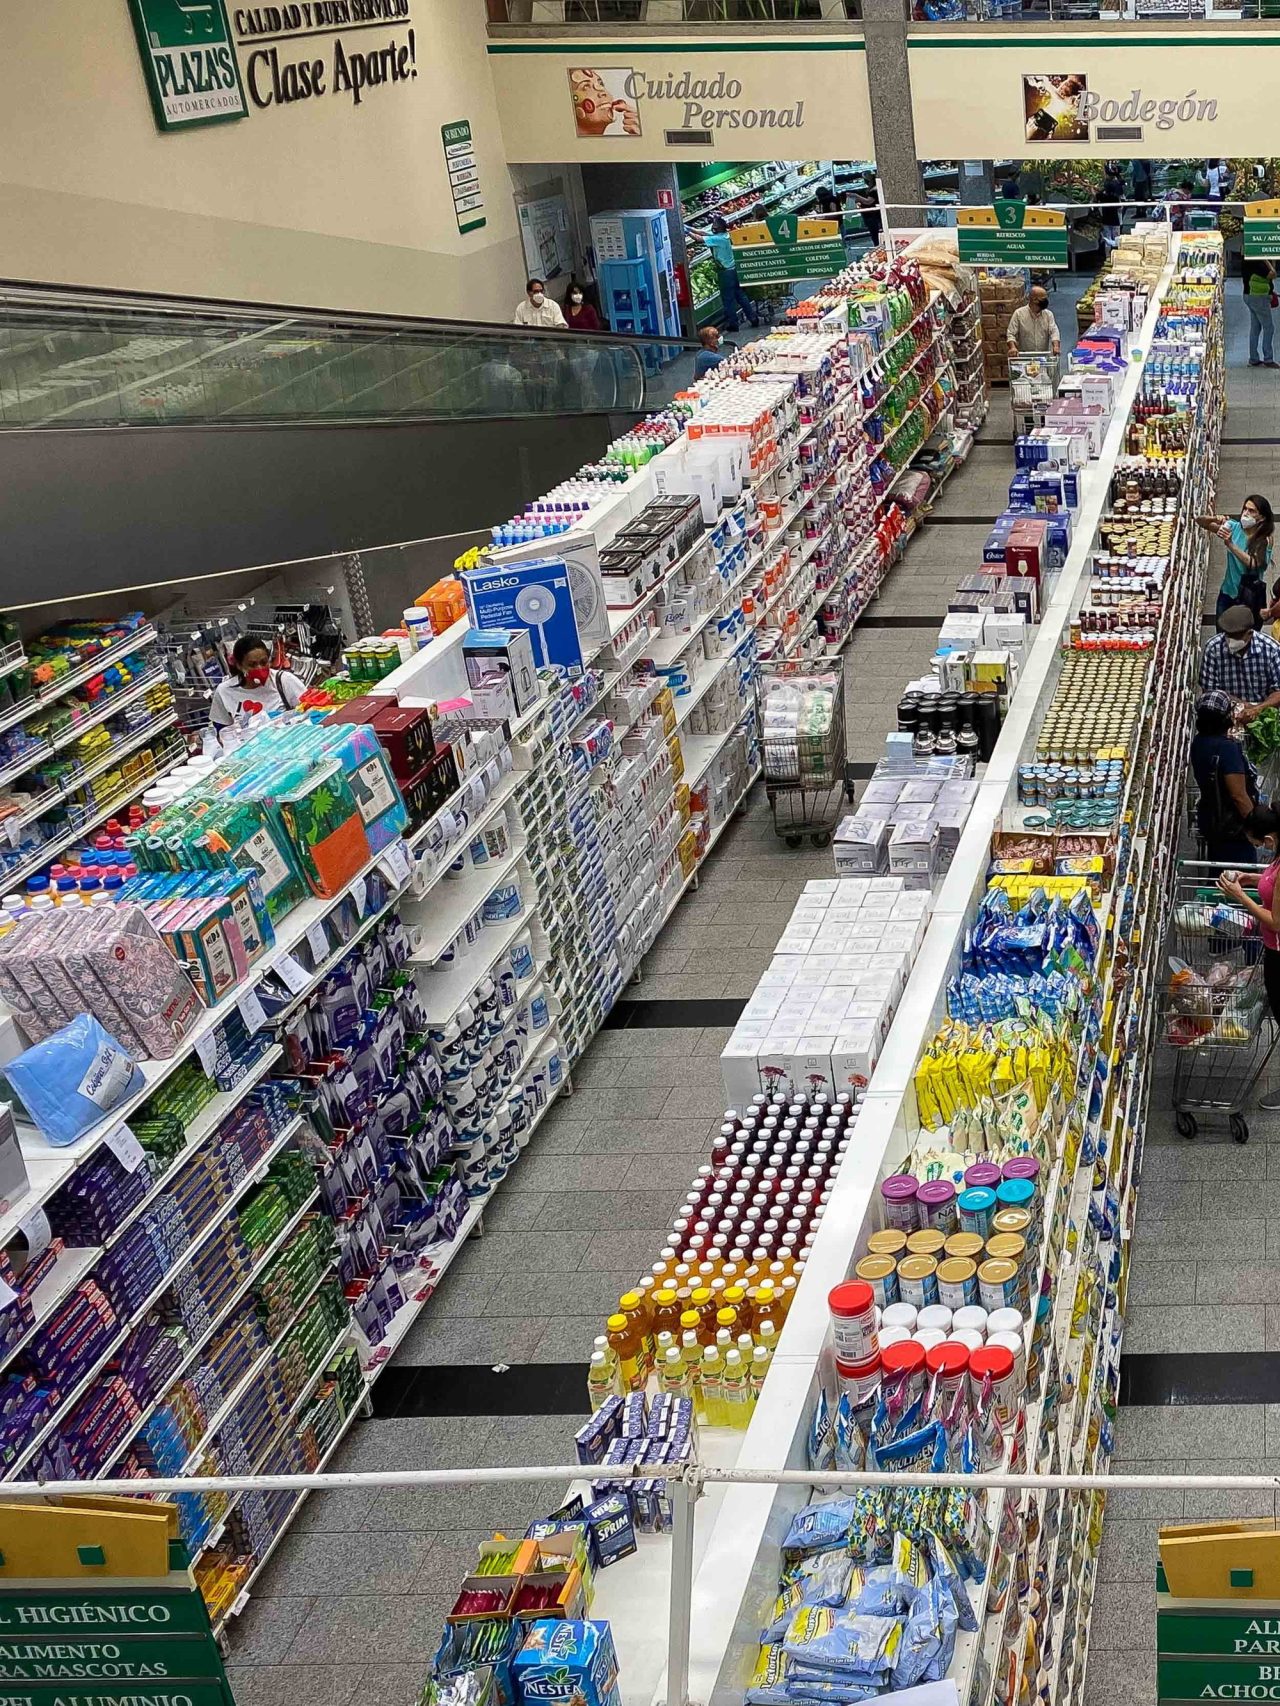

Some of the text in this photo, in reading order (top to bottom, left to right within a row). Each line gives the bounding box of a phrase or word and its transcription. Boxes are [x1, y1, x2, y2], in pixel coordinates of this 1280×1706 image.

[236, 0, 409, 36] CALIDAD Y BUEN SERVICIO
[153, 46, 237, 98] PLAZA'S
[247, 29, 418, 109] Clase Aparte!
[624, 71, 742, 100] Cuidado
[166, 95, 240, 116] AUTOMERCADOS
[1076, 89, 1218, 130] Bodegón
[683, 101, 804, 129] Personal
[1005, 206, 1016, 224] 3
[778, 220, 790, 239] 4
[742, 248, 780, 257] INSECTICIDAS
[743, 270, 788, 280] AMBIENTADORES
[806, 266, 834, 274] ESPONJAS
[986, 552, 1004, 560] Oster
[473, 577, 520, 593] Lasko
[252, 833, 266, 847] KIDS
[234, 896, 248, 913] KIDS
[206, 930, 220, 946] KIDS
[592, 1496, 620, 1518] SPRIM
[597, 1514, 630, 1542] SPRIM
[15, 1603, 170, 1624] HIGIÉNICO
[0, 1645, 120, 1659] ALIMENTO
[33, 1663, 168, 1677] MASCOTAS
[526, 1682, 585, 1697] NESTEA
